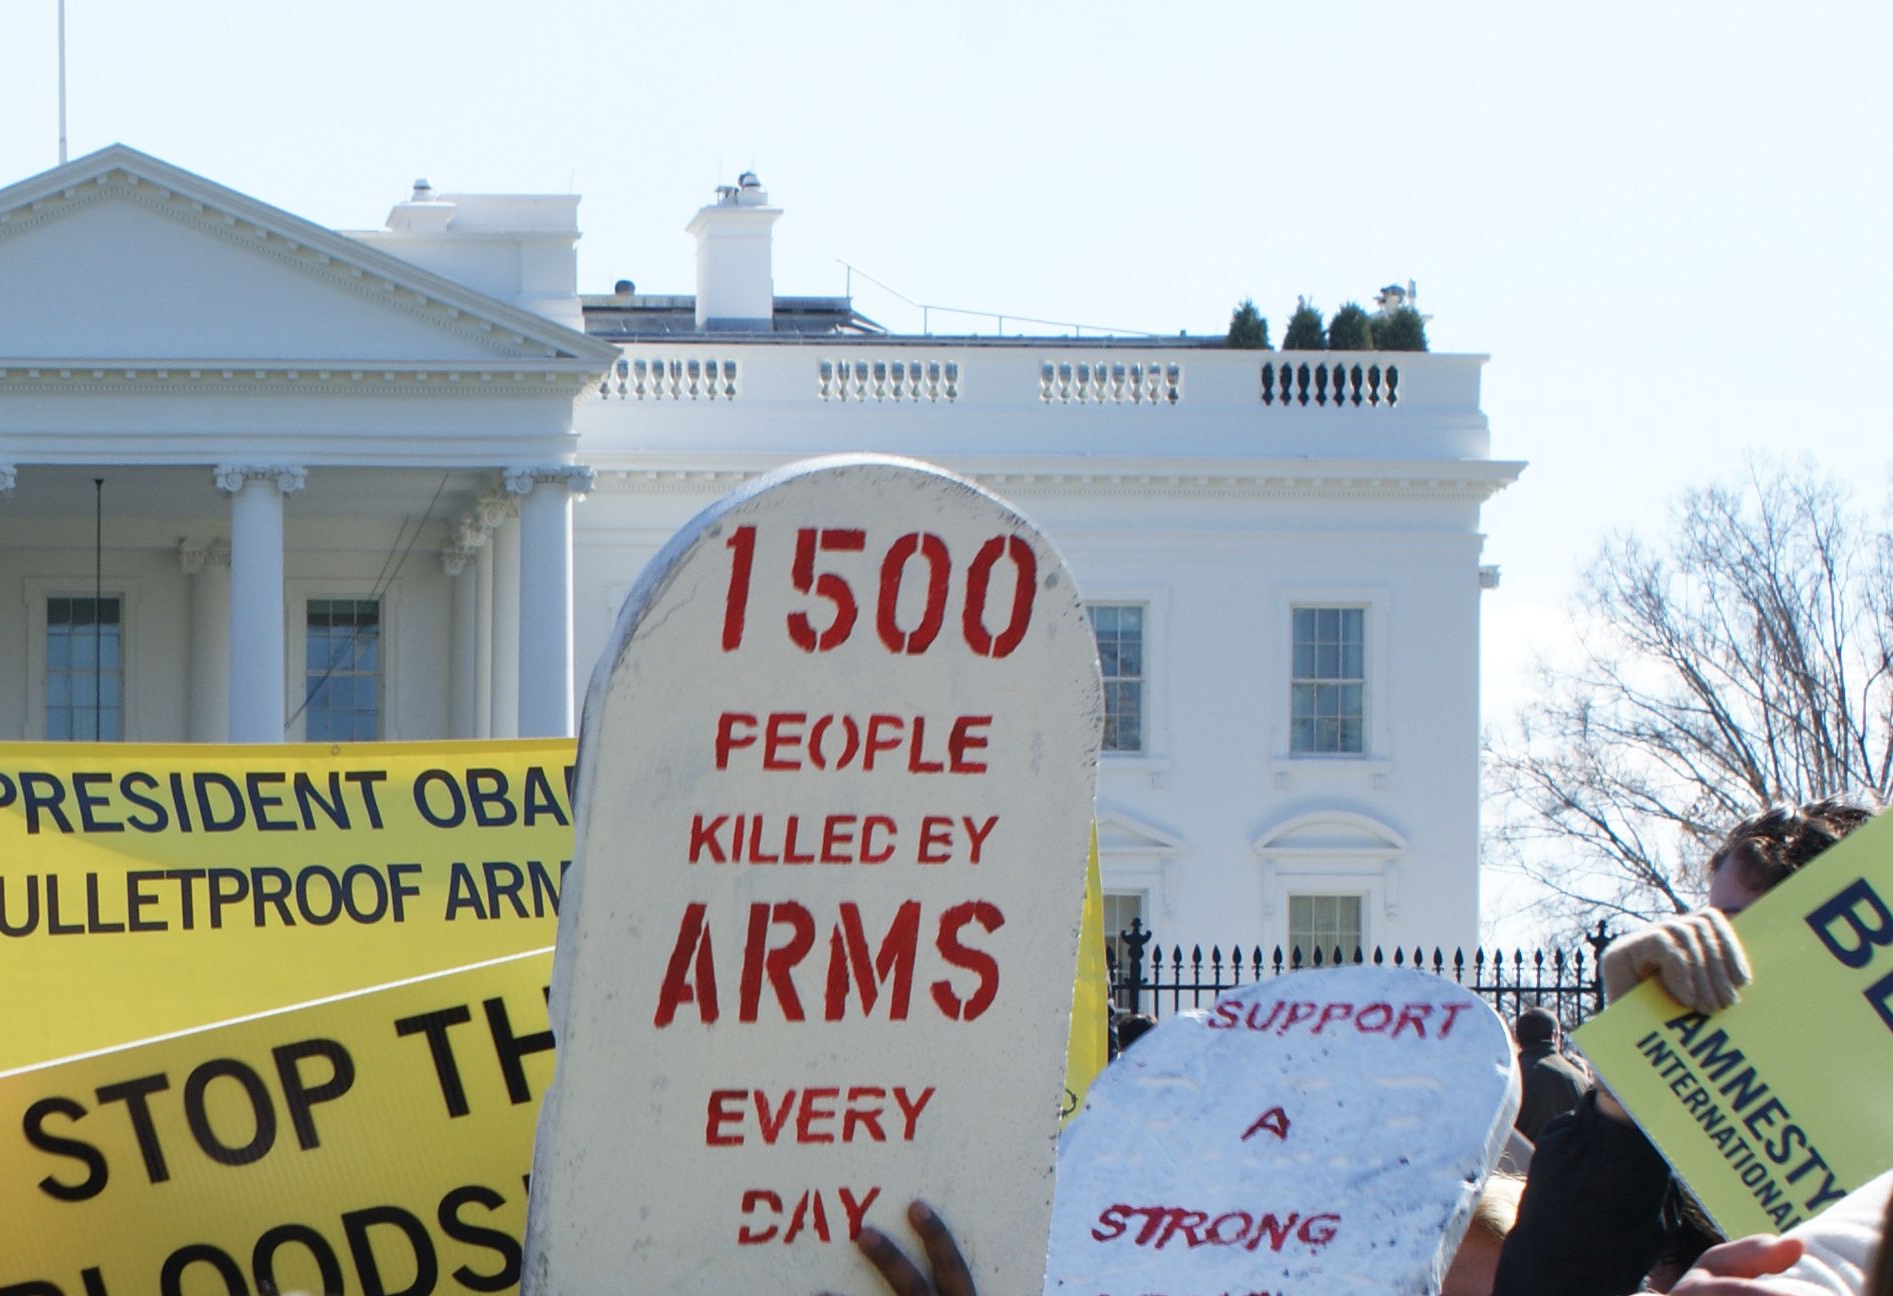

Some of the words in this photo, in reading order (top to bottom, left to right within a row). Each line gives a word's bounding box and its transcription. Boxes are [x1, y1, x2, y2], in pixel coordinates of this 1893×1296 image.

[722, 525, 1038, 659] 1500
[715, 711, 995, 775] PEOPLE
[413, 766, 575, 829] OBA
[689, 814, 898, 866] KILLED
[917, 815, 1000, 866] BY
[654, 900, 1005, 1028] ARMS
[1208, 999, 1473, 1040] SUPPORT
[21, 1037, 355, 1203] STOP
[705, 1085, 937, 1147] EVERY
[1241, 1106, 1291, 1141] A
[1664, 1012, 1848, 1212] AMNESTY
[738, 1186, 882, 1245] DAY
[1091, 1204, 1341, 1251] STRONG
